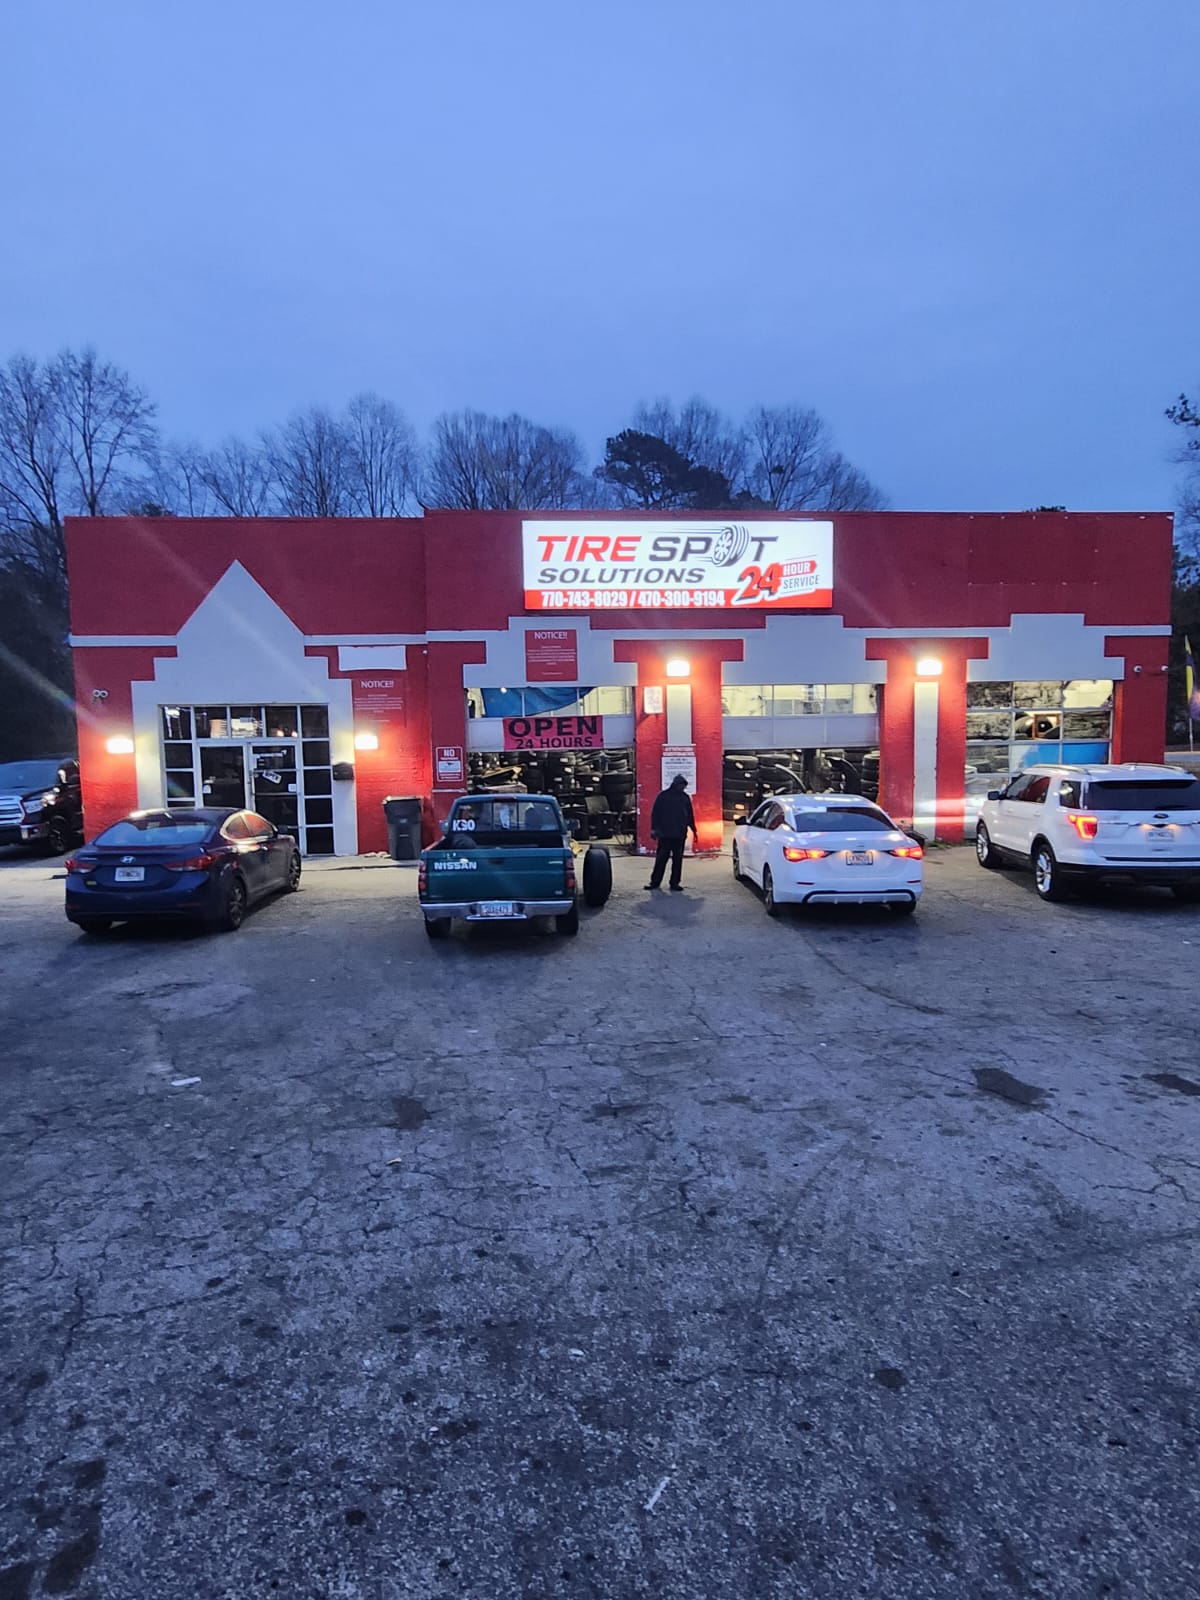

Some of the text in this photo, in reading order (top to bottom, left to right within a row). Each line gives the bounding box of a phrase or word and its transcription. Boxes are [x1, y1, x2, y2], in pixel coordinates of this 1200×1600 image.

[537, 535, 642, 561] TIRE
[537, 567, 706, 584] SOLUTIONS
[736, 561, 812, 601] 24 HOUR
[783, 575, 820, 589] SERVICE
[541, 592, 628, 607] 770-743-8029
[638, 590, 726, 607] 470-300-9194
[509, 717, 597, 737] OPEN
[516, 737, 593, 750] 24 HOURS
[443, 748, 455, 757] NO
[433, 861, 477, 870] NISSAN
